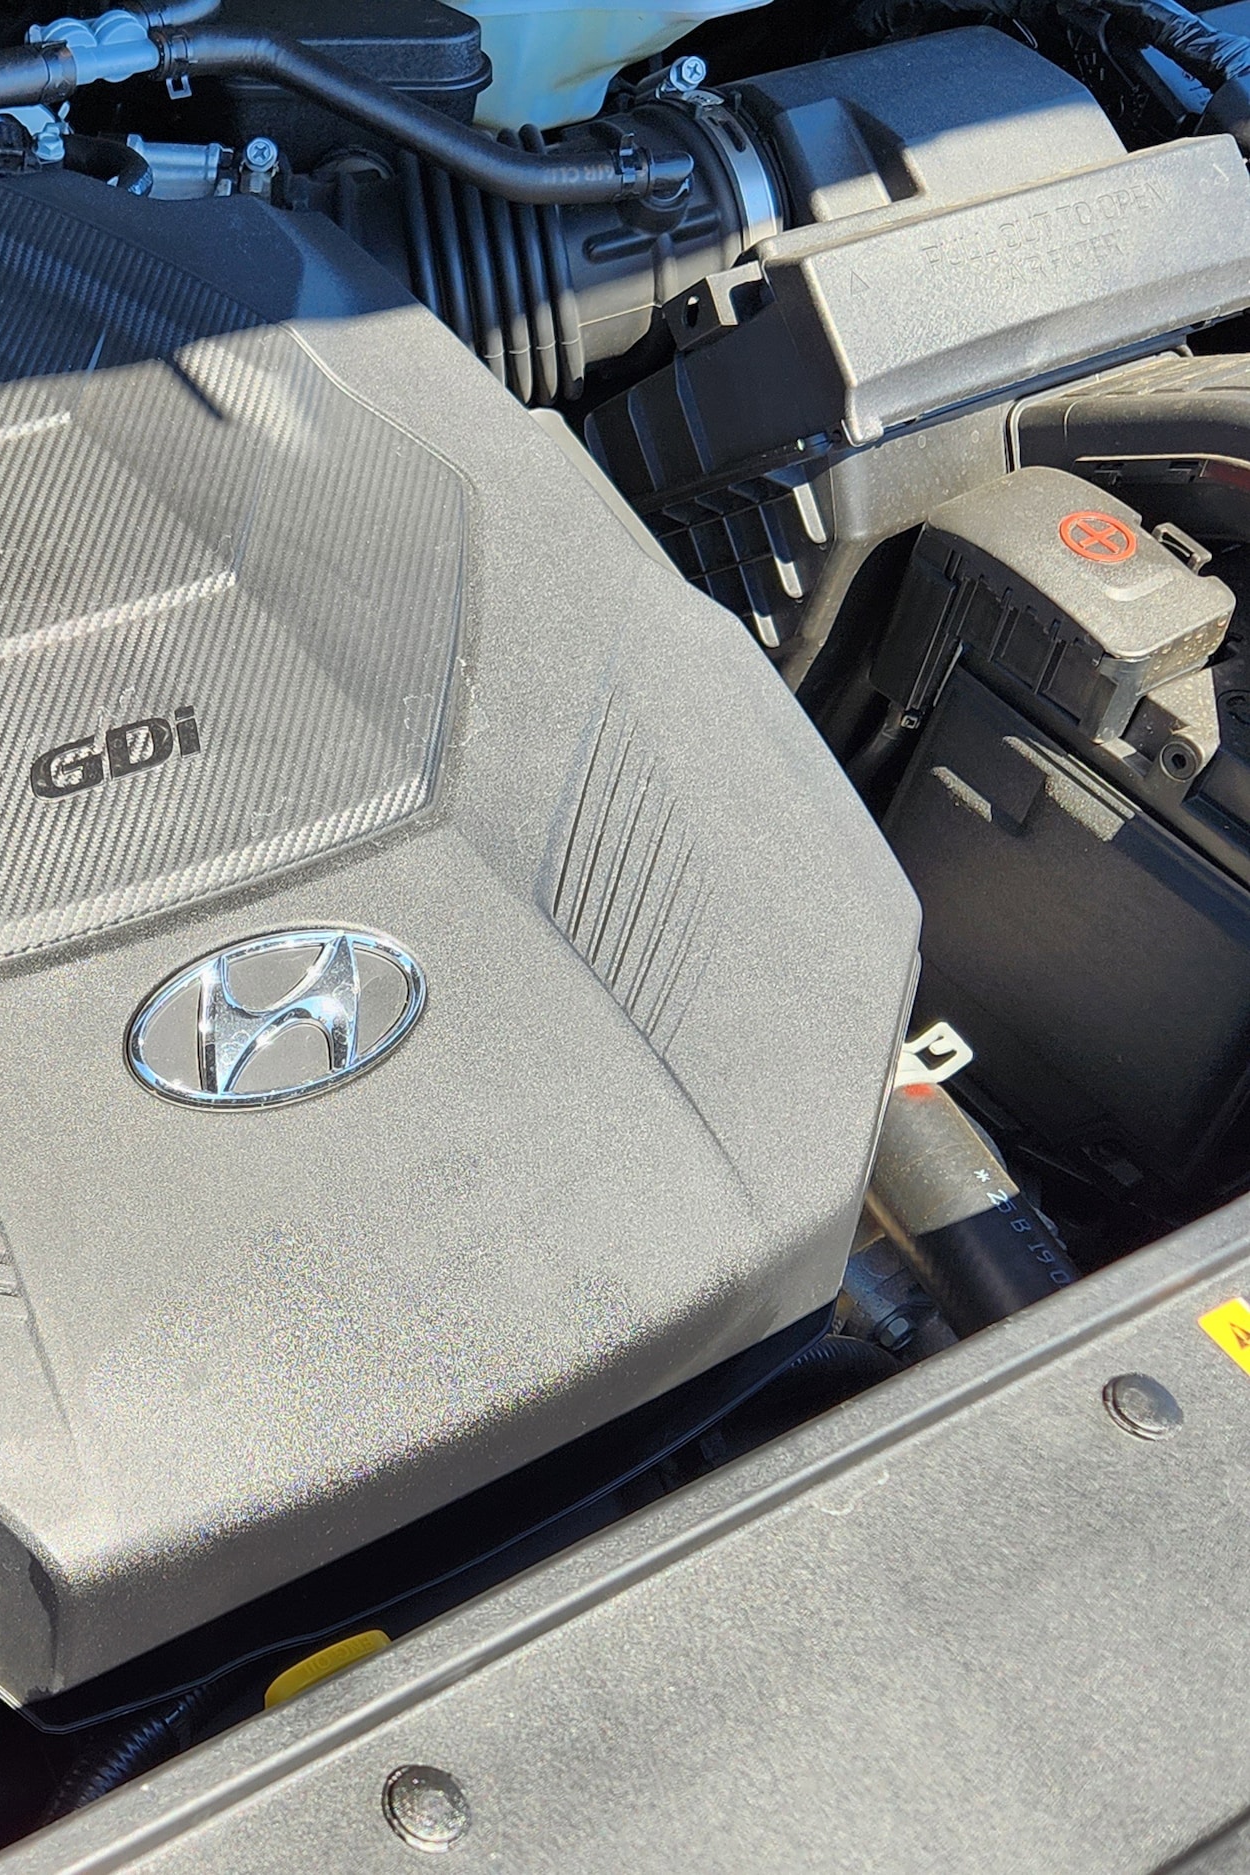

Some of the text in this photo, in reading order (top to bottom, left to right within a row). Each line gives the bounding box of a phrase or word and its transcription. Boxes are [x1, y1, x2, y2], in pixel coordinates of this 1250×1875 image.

[999, 210, 1051, 249] OUT
[1056, 201, 1092, 226] TO
[1096, 180, 1167, 219] OPEN
[30, 705, 201, 800] GDi
